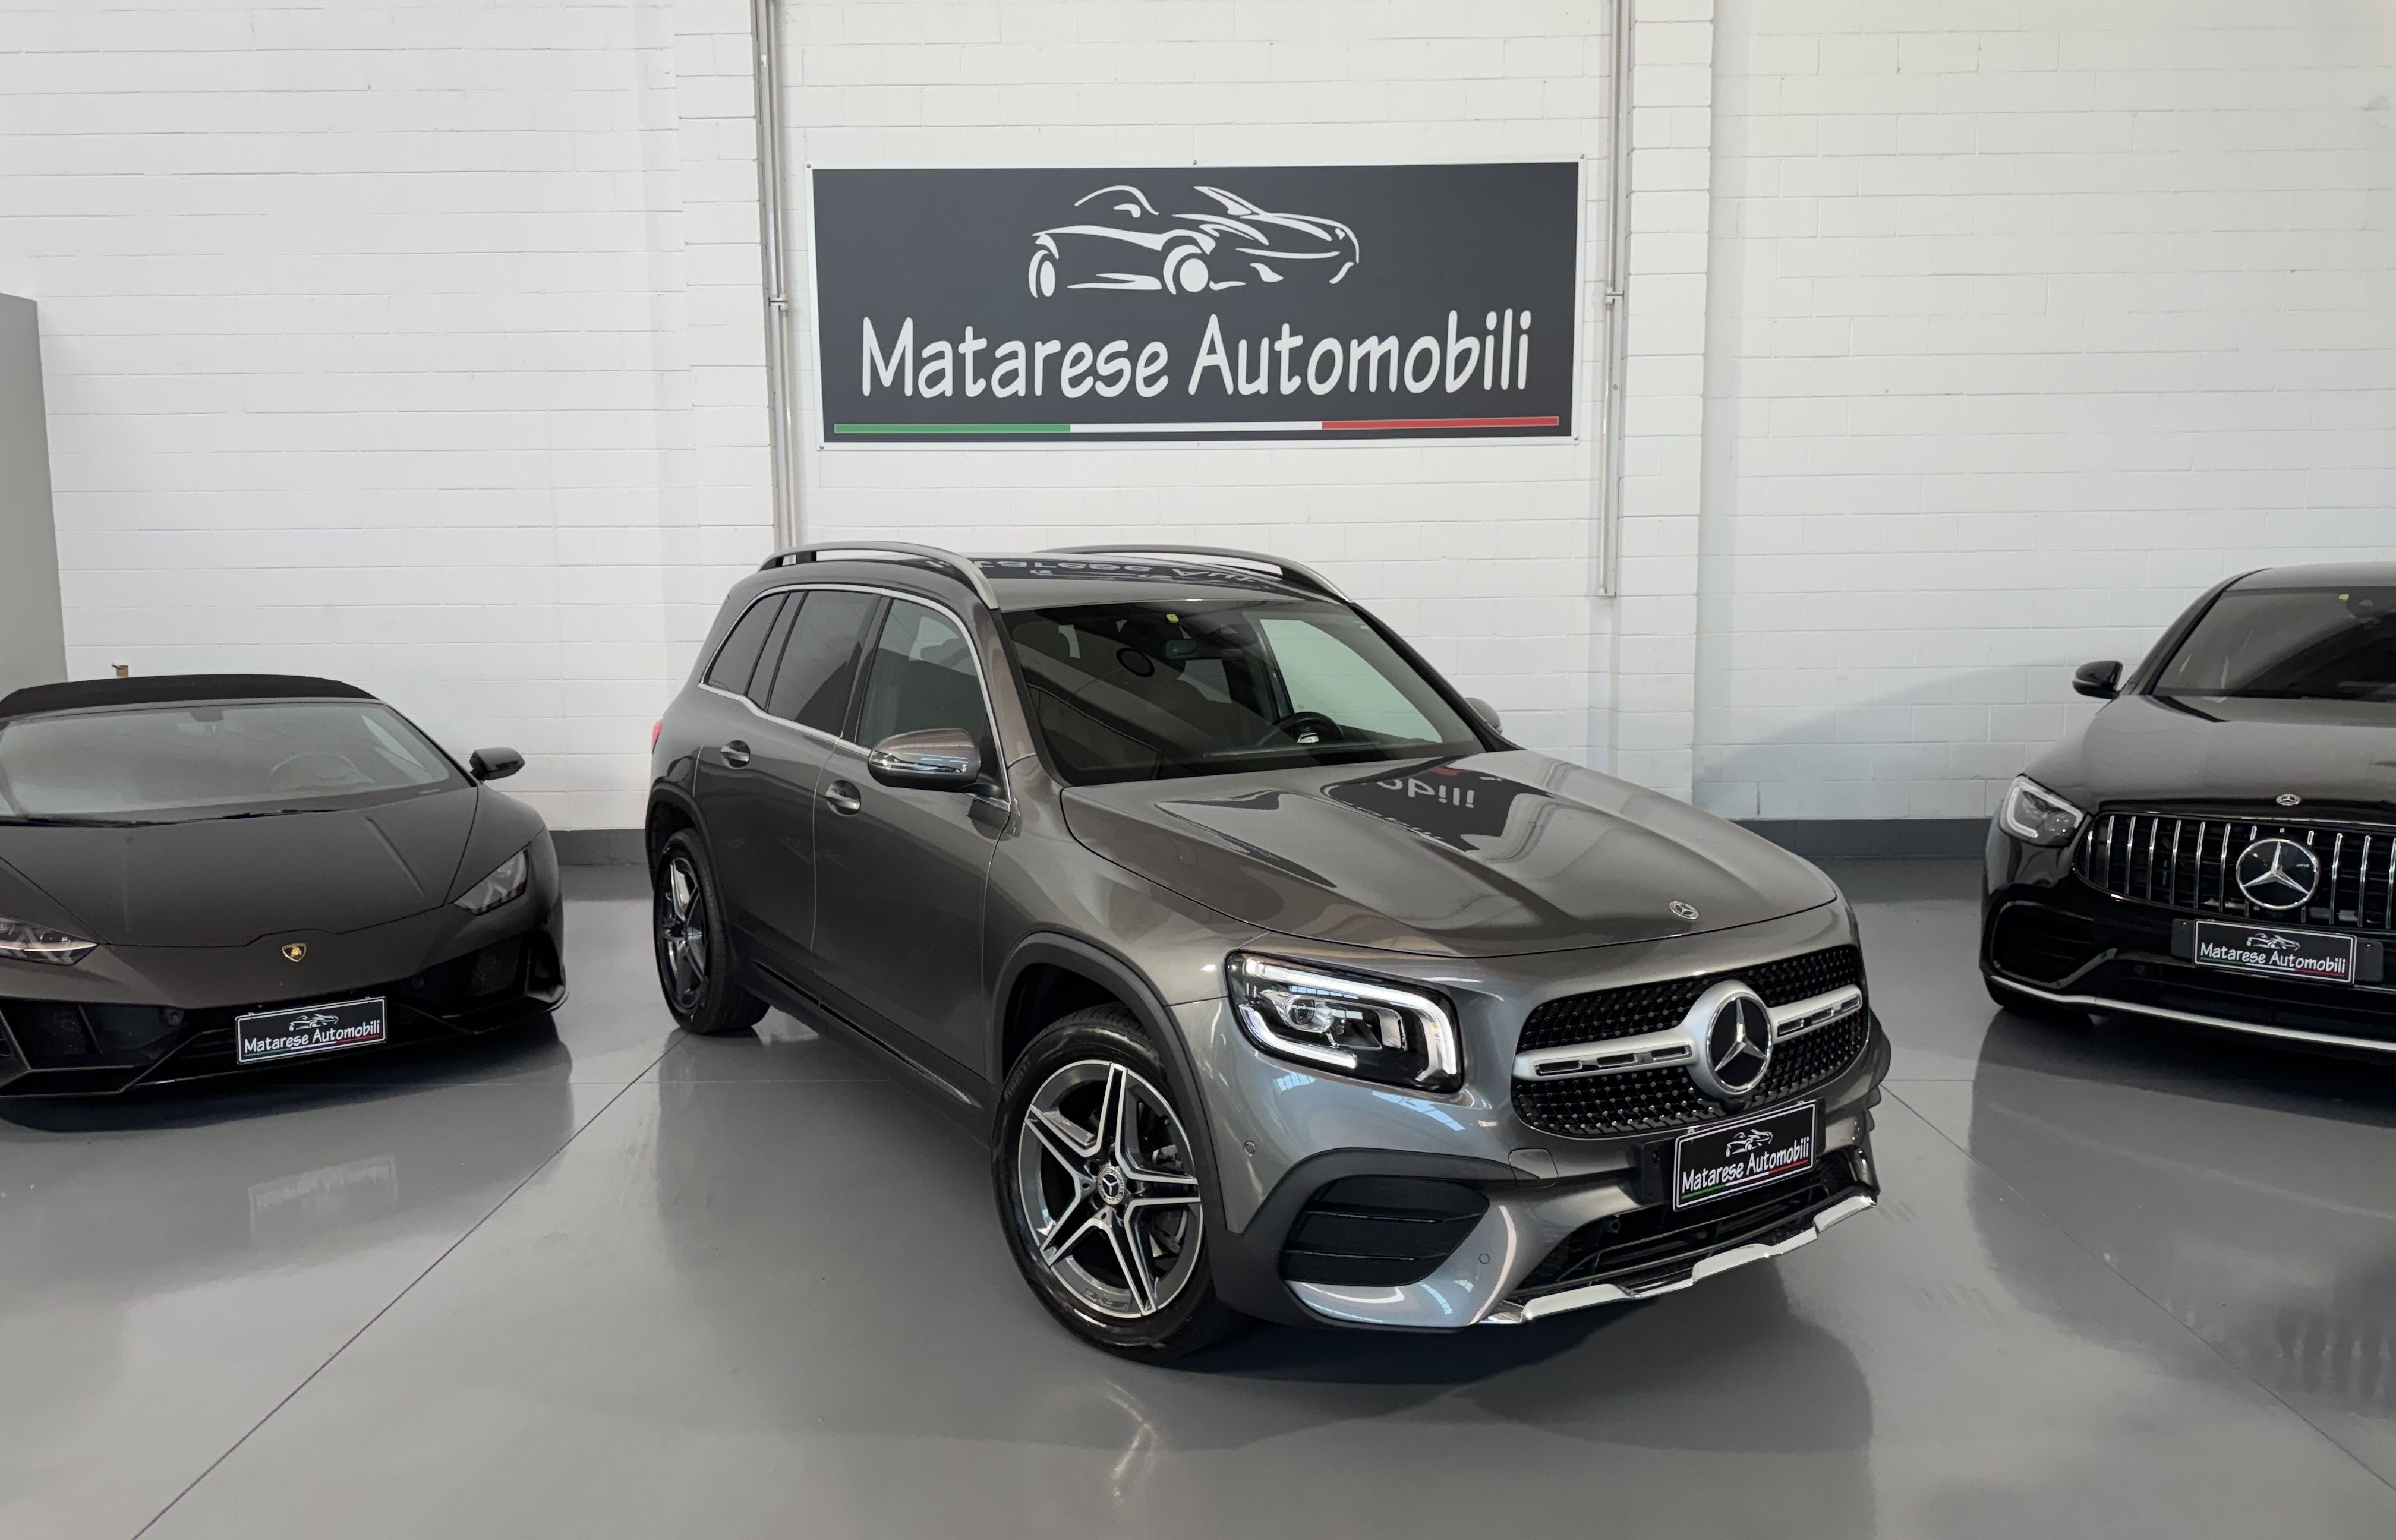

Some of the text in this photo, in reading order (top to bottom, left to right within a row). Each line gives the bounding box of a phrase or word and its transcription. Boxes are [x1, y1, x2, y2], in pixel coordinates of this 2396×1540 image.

[862, 308, 1532, 399] Matarese Automobili
[2200, 942, 2346, 973] Matarese Automobili
[244, 1020, 380, 1054] Matarese Automobili
[1682, 1136, 1810, 1194] Matarese Automobili
